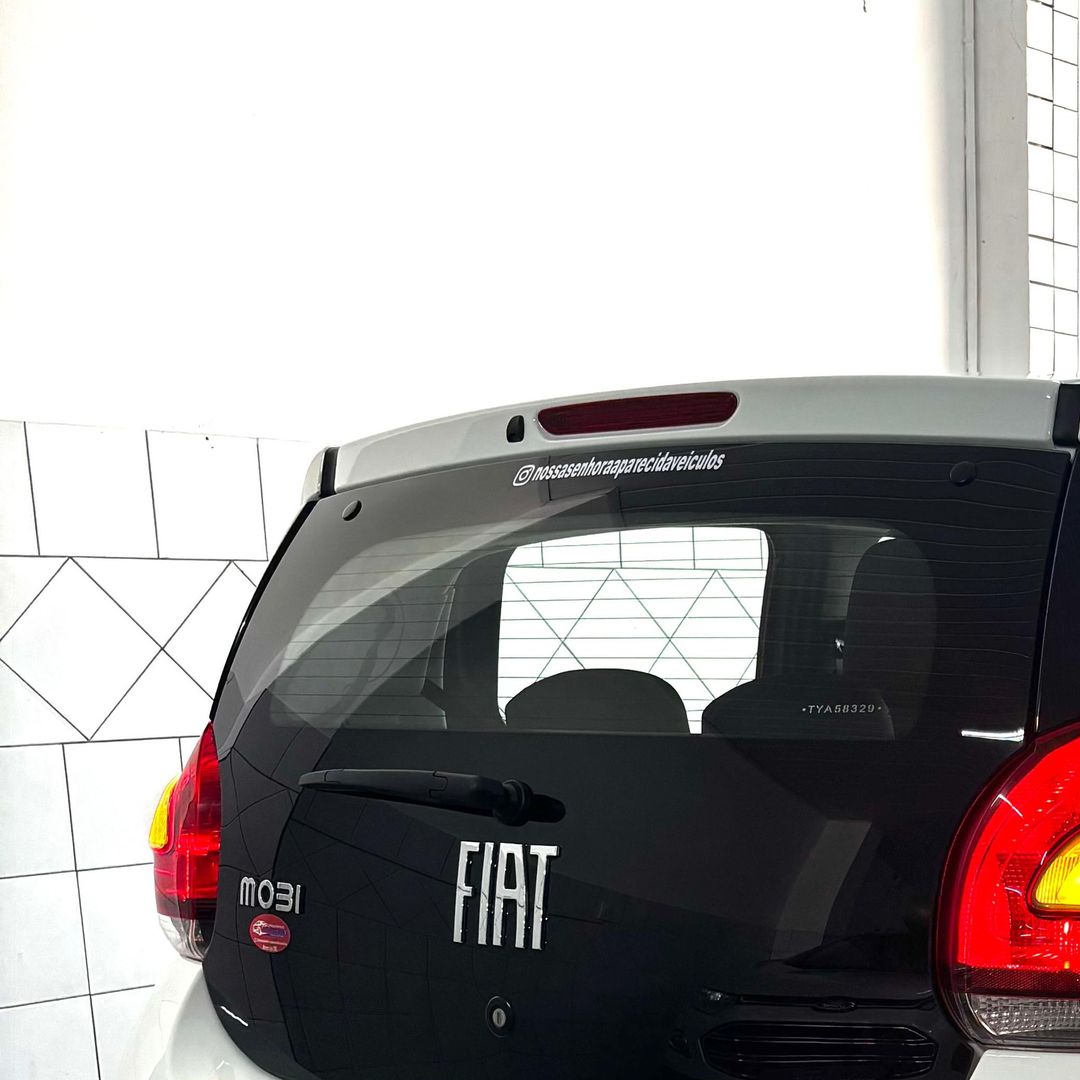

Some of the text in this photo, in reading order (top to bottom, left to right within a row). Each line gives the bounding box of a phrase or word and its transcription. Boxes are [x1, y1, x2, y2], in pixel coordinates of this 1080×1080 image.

[532, 450, 726, 481] nossasenhoraaparecidaveiculos
[239, 876, 302, 915] MOBI
[452, 841, 560, 951] FIAT
